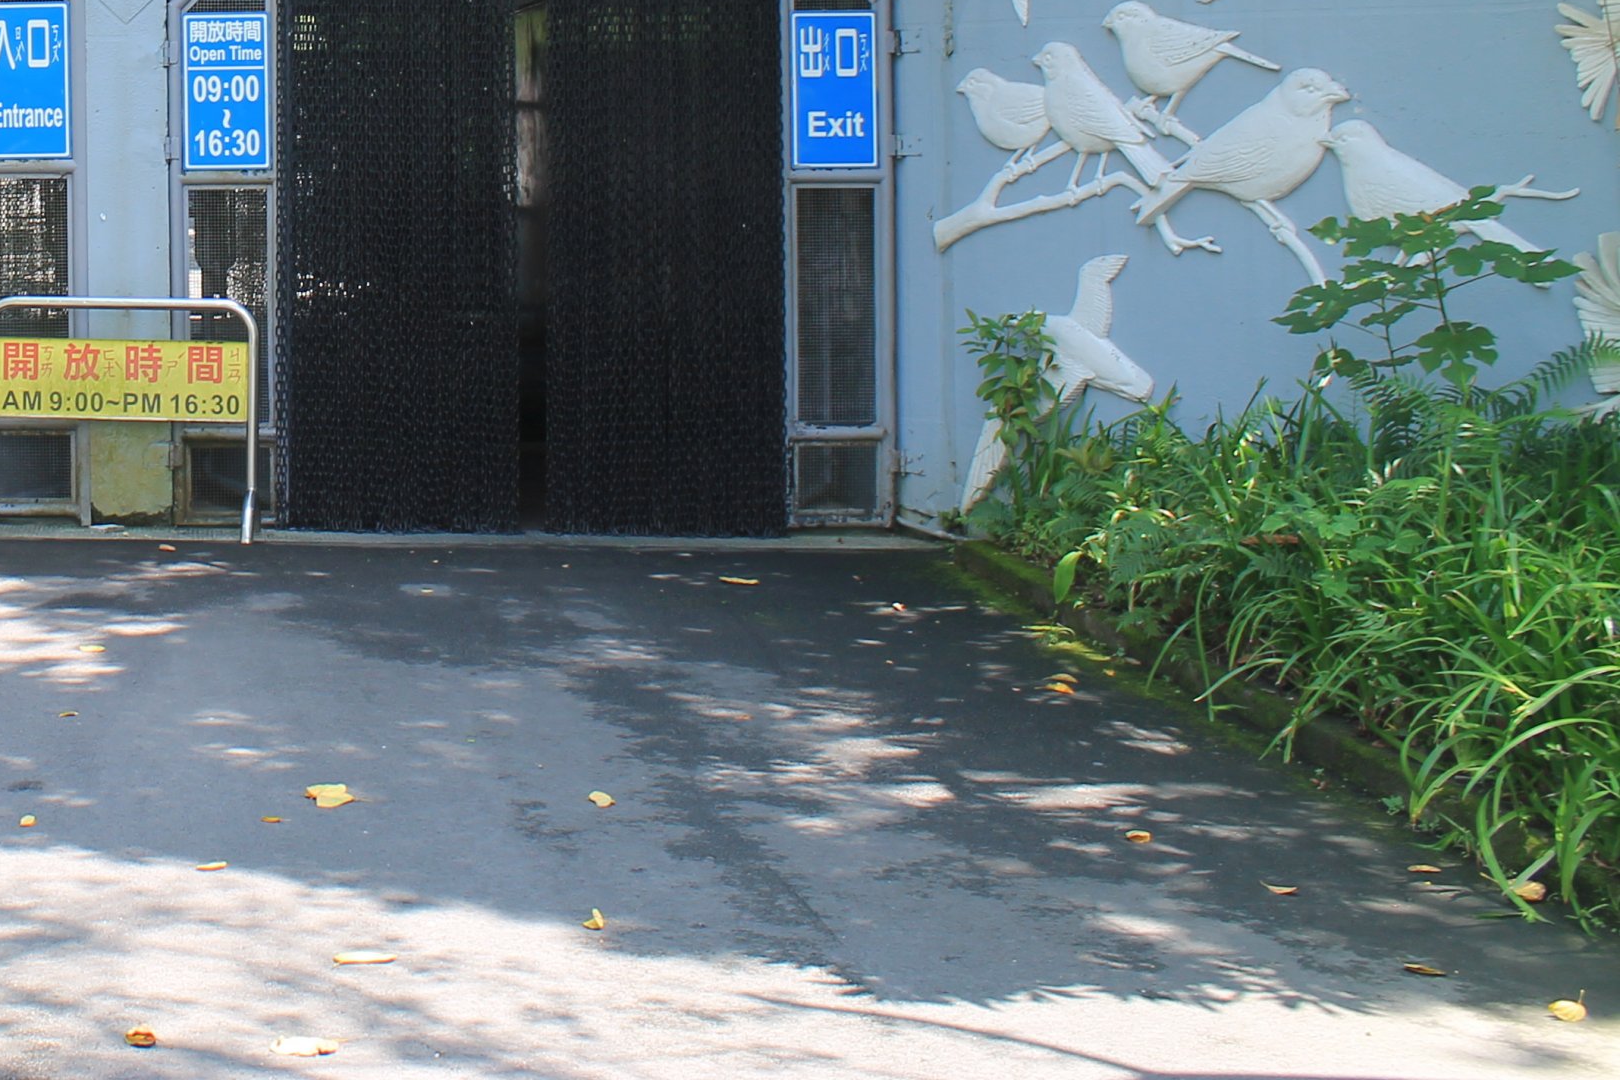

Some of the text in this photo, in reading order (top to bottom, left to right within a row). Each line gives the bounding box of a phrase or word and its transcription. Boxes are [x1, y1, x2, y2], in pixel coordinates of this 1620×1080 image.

[189, 20, 261, 43] 開放時間
[189, 44, 262, 65] Open Time
[800, 26, 858, 78] 出口
[192, 75, 260, 103] 09:00
[807, 110, 865, 138] Exit
[194, 129, 261, 157] 16:30
[2, 342, 224, 384] 開放時間
[2, 390, 42, 411] AM
[170, 393, 240, 415] 16:30
